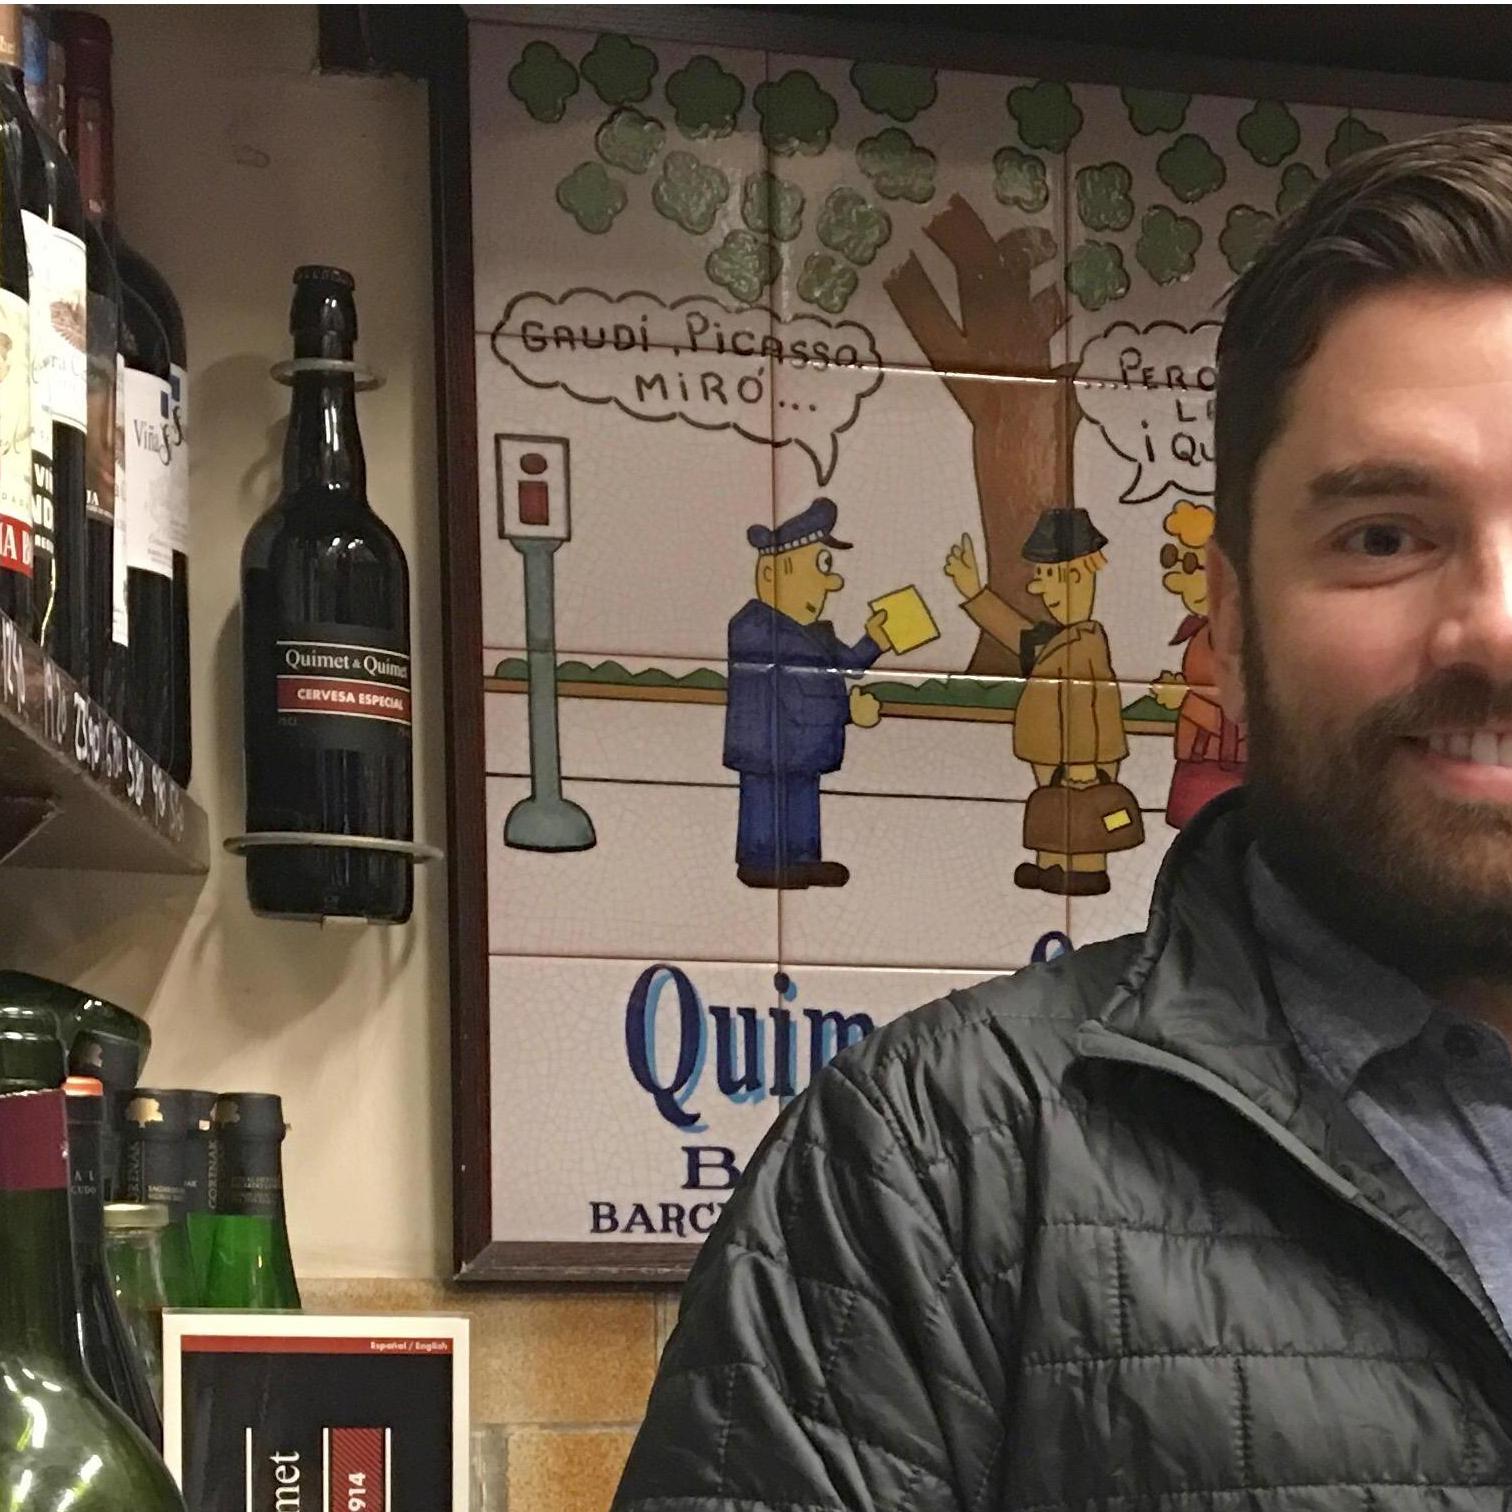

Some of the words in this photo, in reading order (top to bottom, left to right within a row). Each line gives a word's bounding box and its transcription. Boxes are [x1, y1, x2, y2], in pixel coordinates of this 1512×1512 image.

[285, 648, 350, 671] Quimet
[297, 688, 356, 704] CERVESA
[358, 692, 404, 711] ESPECIAL
[590, 1200, 730, 1236] BARC
